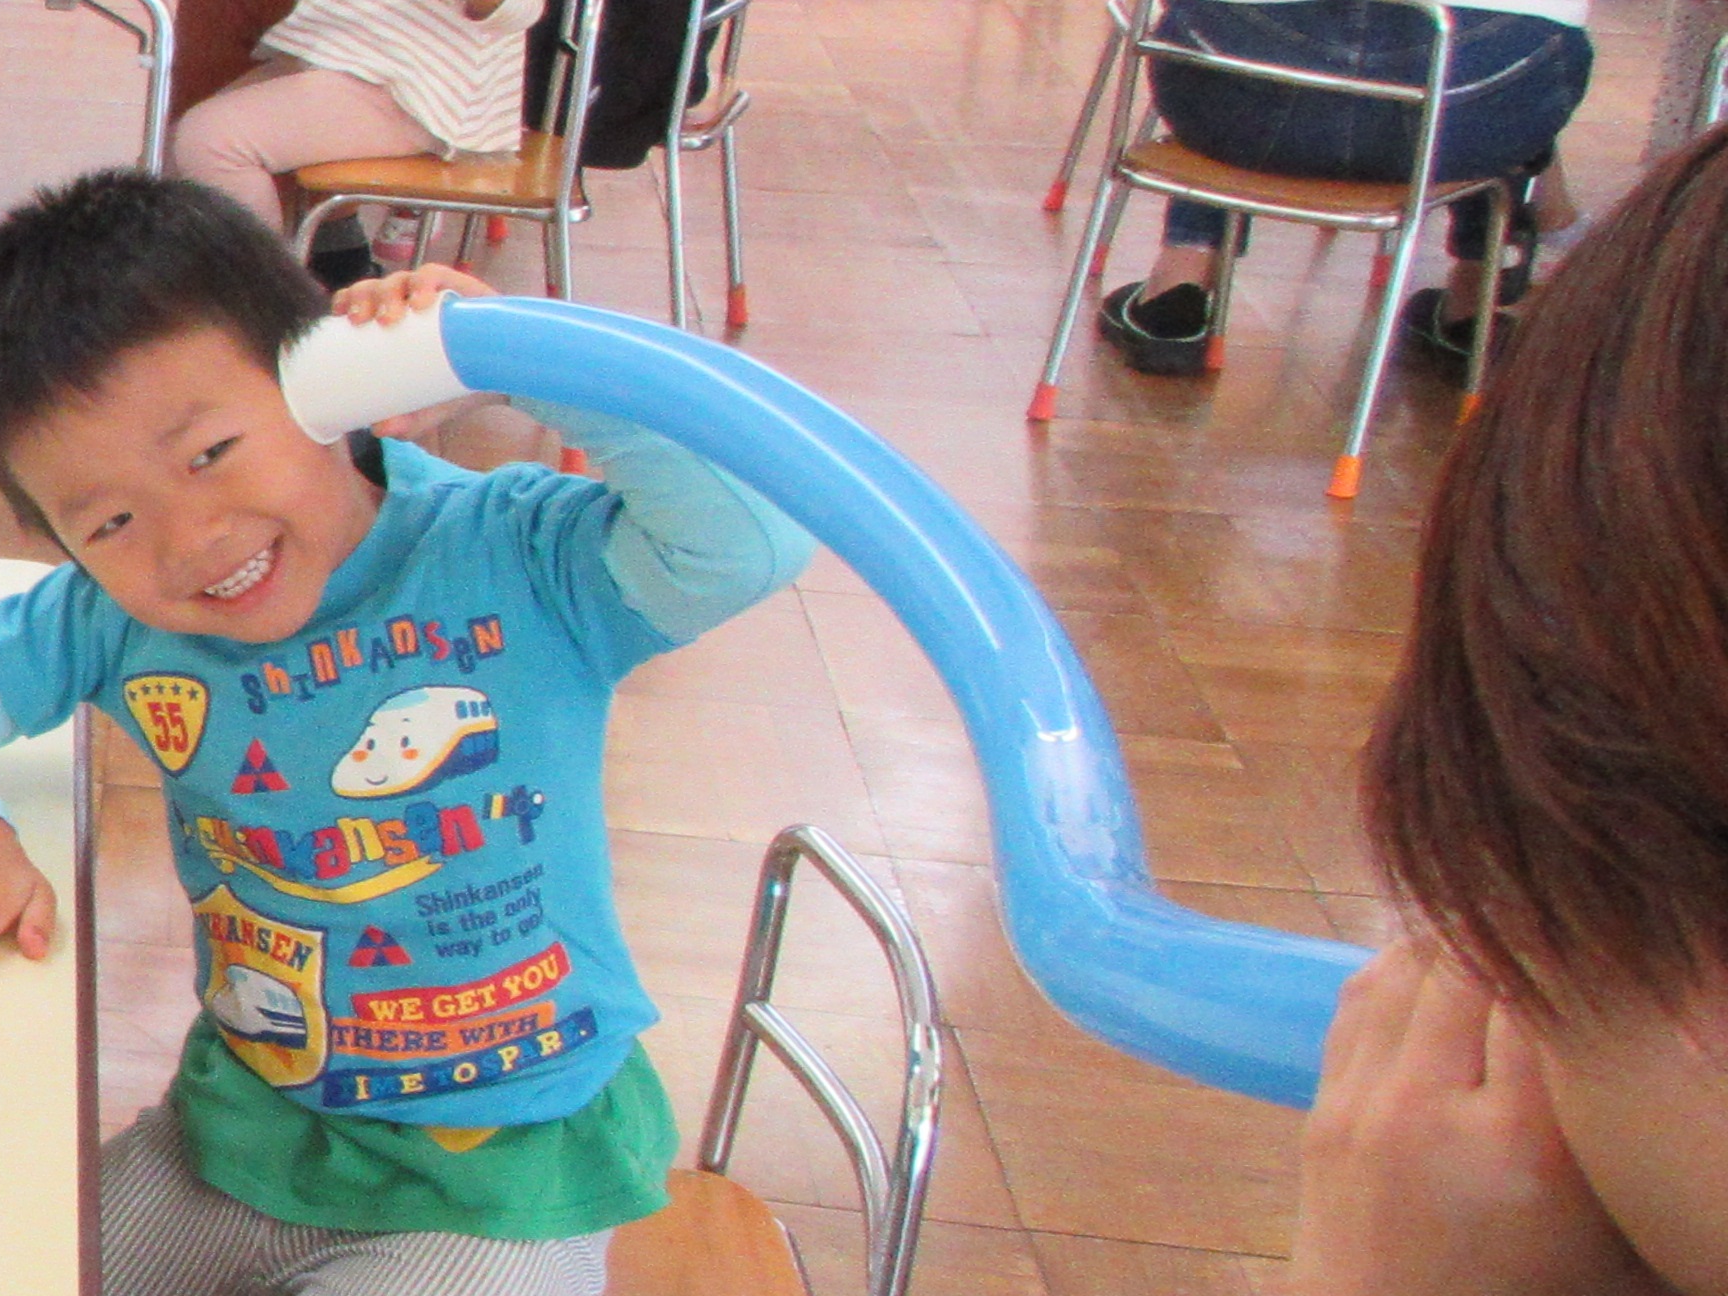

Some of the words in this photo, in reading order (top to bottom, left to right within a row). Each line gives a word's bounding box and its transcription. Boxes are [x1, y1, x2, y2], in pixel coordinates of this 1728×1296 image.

[147, 700, 189, 754] 55
[415, 862, 545, 917] Shinkansen
[427, 919, 452, 937] is
[460, 909, 498, 933] the
[504, 886, 544, 916] only
[434, 937, 483, 959] way
[491, 927, 512, 947] to
[367, 997, 425, 1022] WE
[431, 983, 498, 1018] GET
[501, 952, 561, 997] YOU
[330, 1024, 448, 1052] THERE
[459, 1013, 539, 1047] WITH
